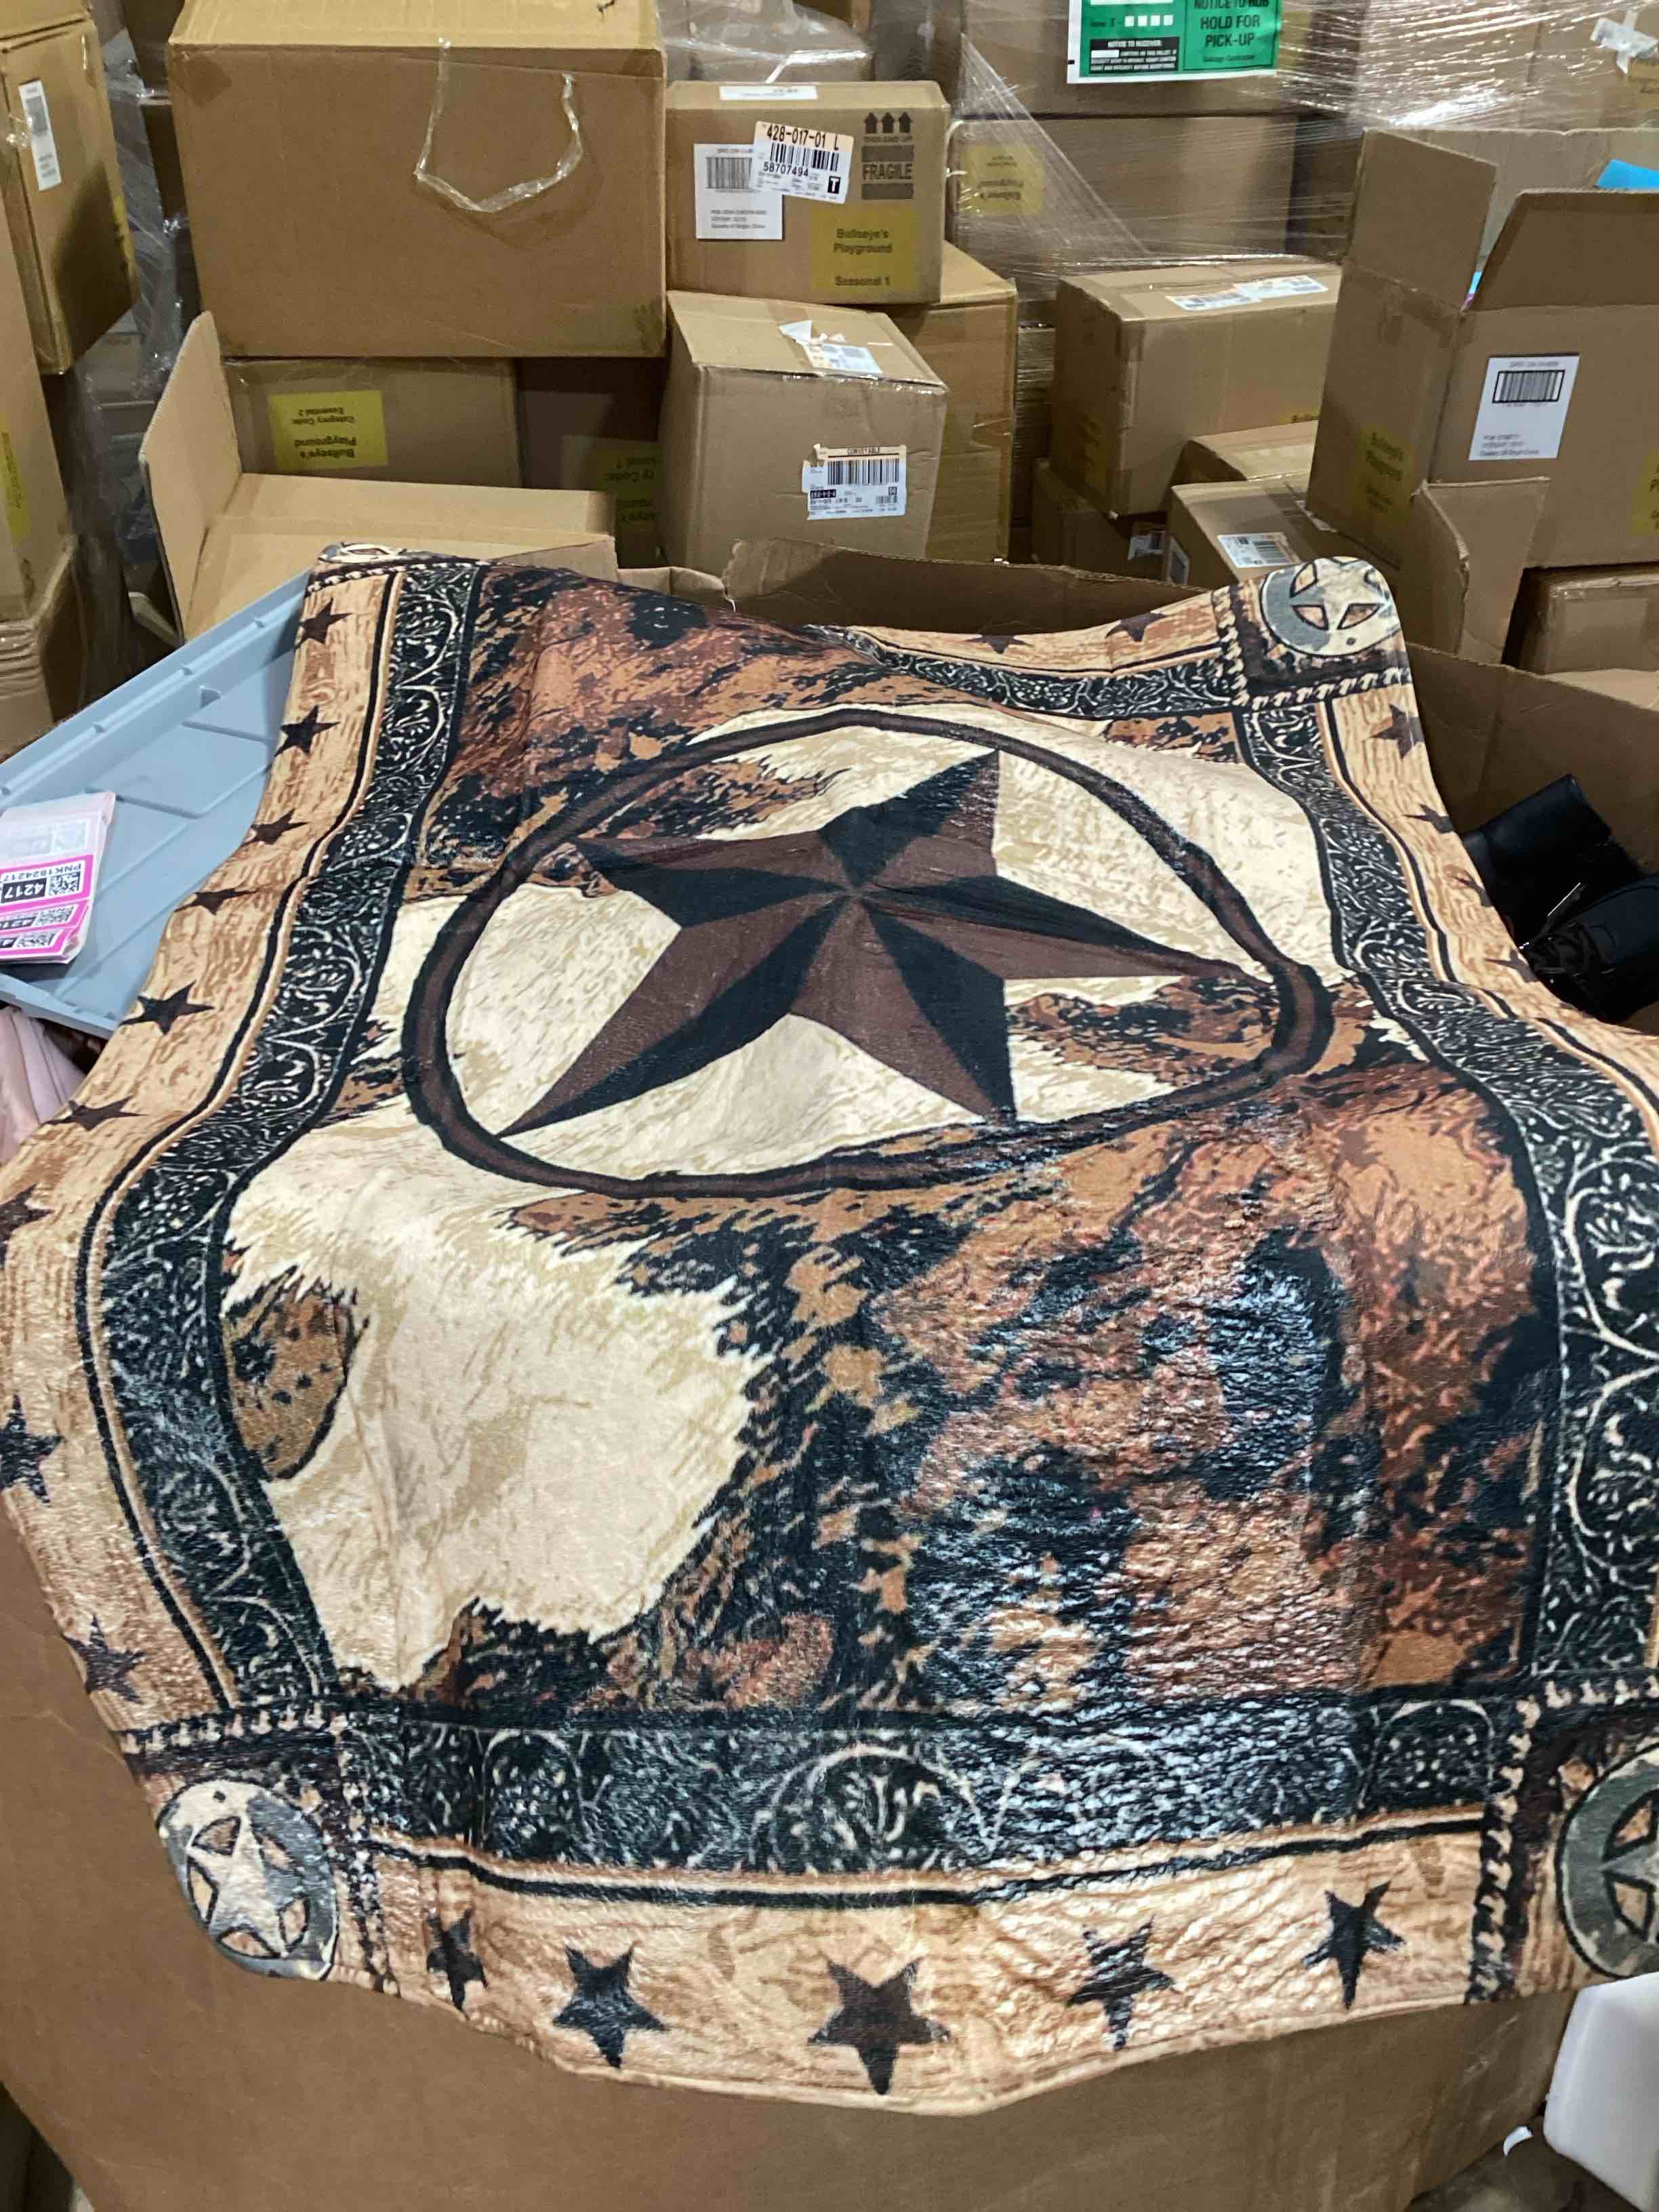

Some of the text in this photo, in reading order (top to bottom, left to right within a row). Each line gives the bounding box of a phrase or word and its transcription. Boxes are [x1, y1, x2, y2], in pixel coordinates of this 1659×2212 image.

[1200, 15, 1261, 29] HOLD FOR
[1204, 33, 1254, 47] PICK-UP
[766, 125, 839, 150] 428-017-01 L
[764, 161, 808, 177] 58707494
[862, 163, 913, 181] FRAGILE
[830, 177, 840, 193] T
[836, 228, 890, 241] Bullseye's
[834, 243, 893, 255] Playground
[4, 882, 44, 899] 4217
[0, 917, 33, 929] 421
